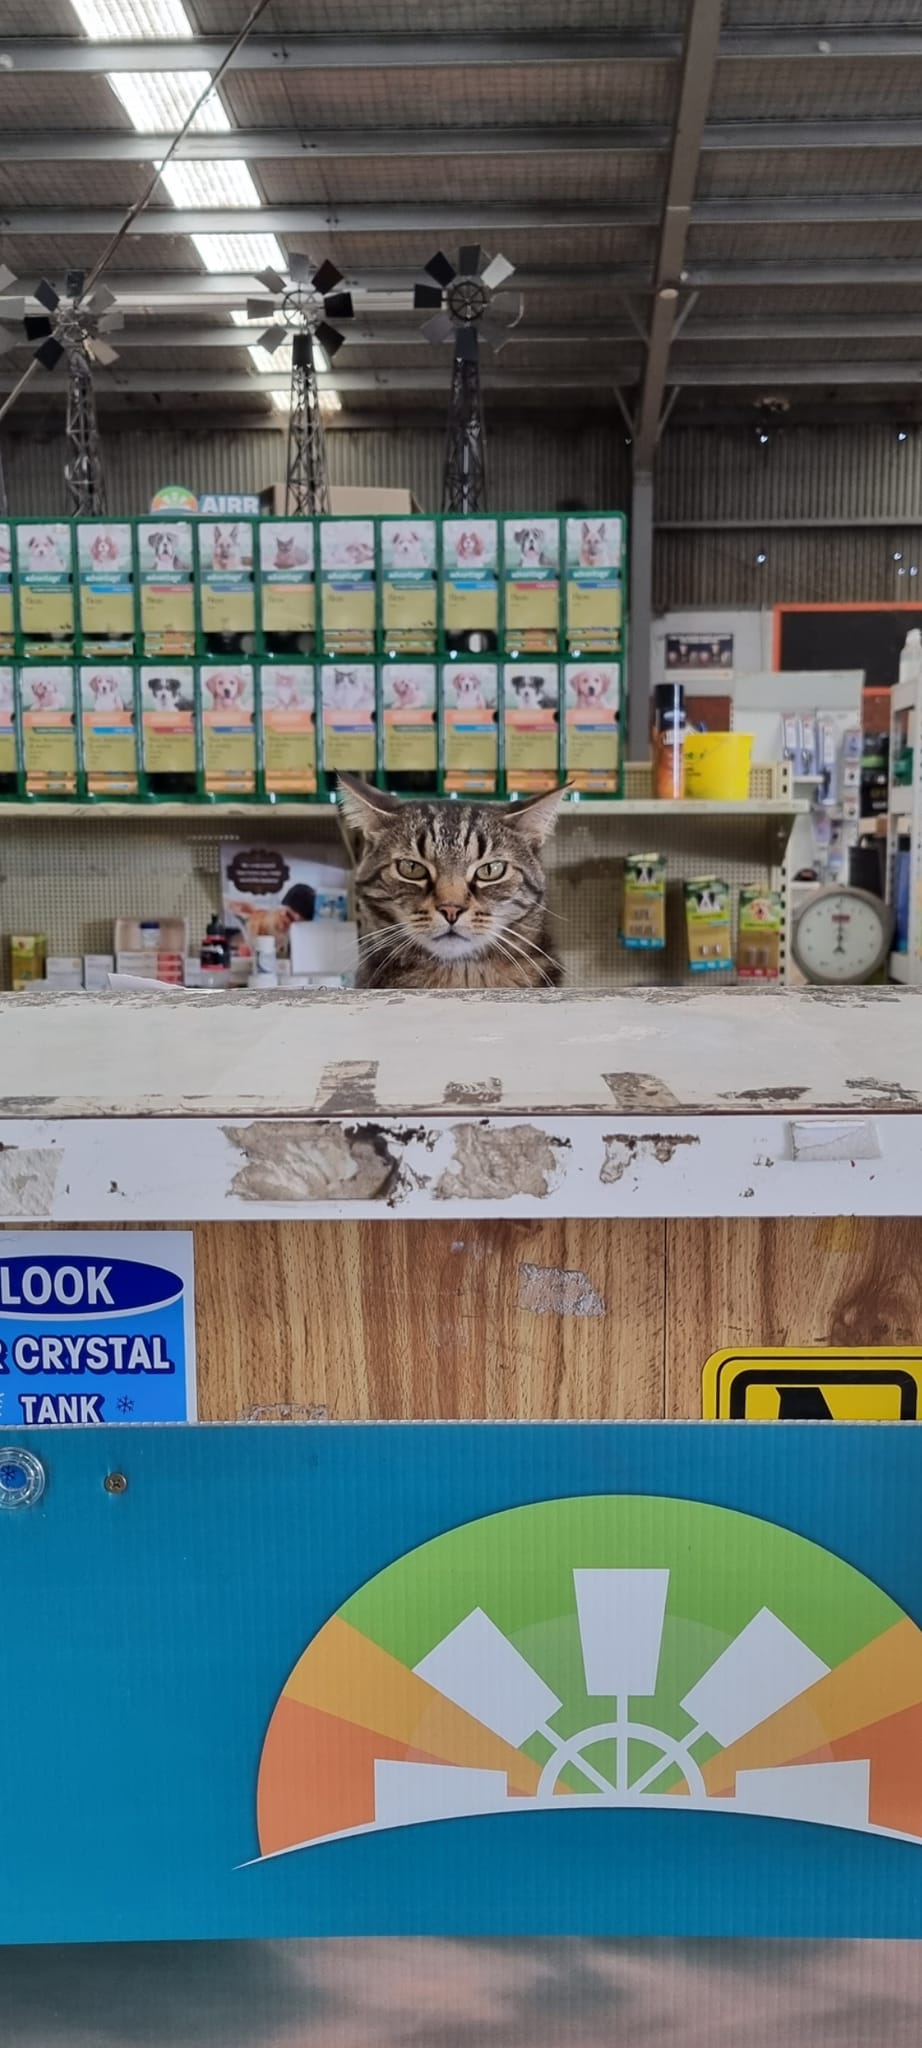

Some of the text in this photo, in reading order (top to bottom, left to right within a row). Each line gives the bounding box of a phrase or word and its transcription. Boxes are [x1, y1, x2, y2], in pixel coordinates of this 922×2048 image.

[202, 495, 259, 513] AIRR
[1, 1265, 115, 1306] LOOK
[14, 1336, 171, 1371] CRYSTAL
[20, 1396, 102, 1423] TANK
